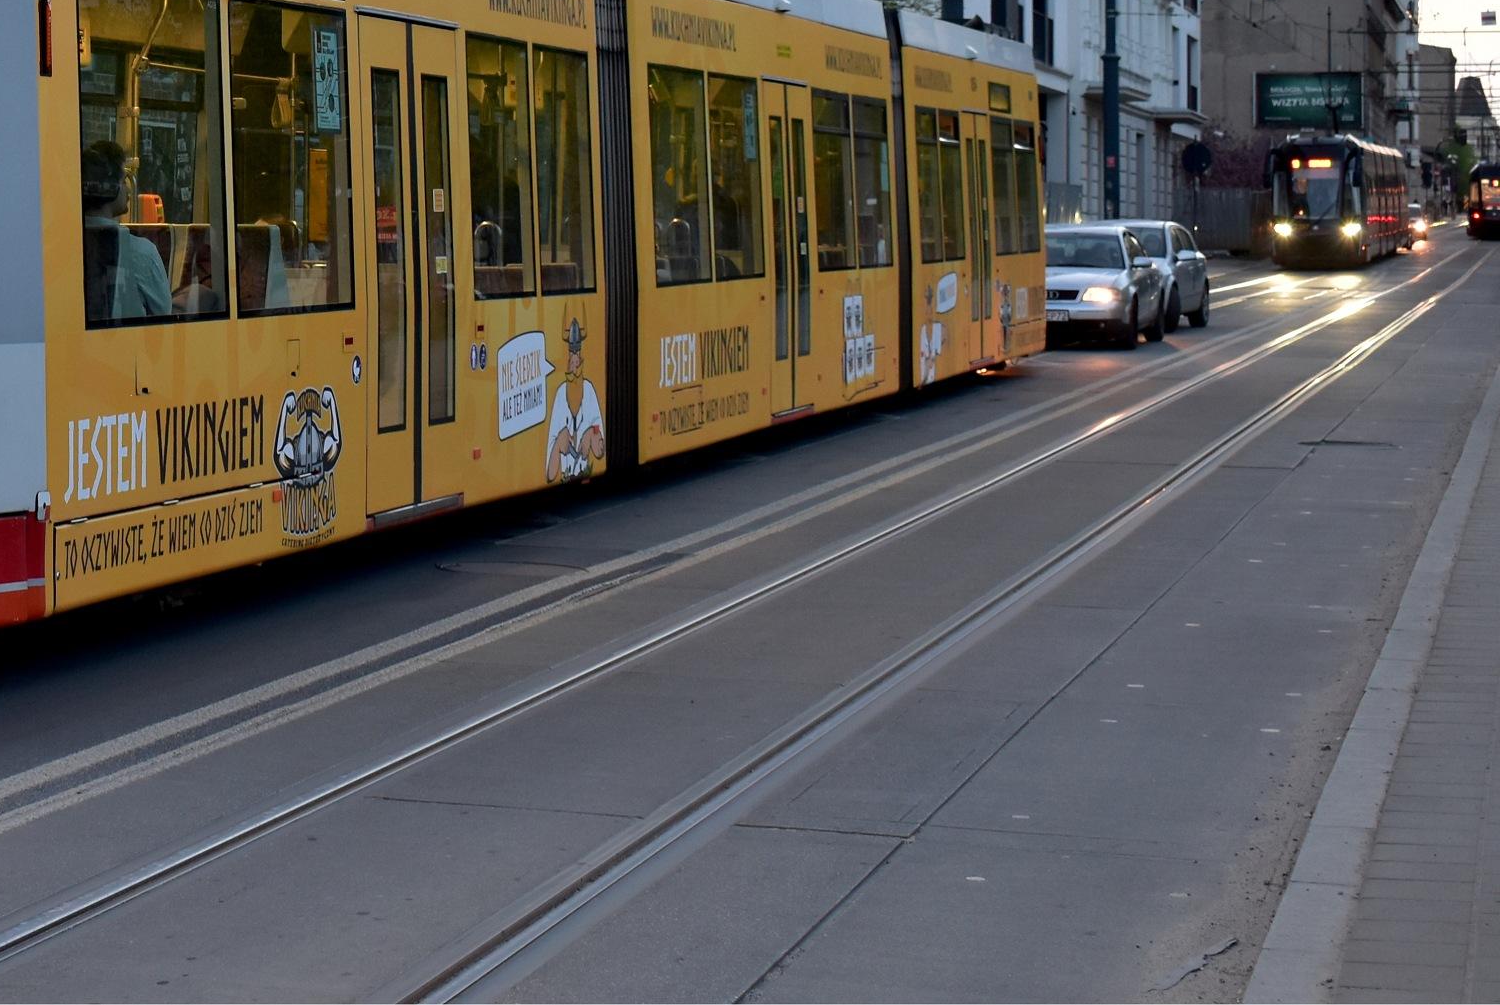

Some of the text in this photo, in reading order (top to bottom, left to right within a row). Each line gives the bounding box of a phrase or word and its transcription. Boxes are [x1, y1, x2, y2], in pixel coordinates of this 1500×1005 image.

[659, 324, 749, 388] JESTEM VIKINGIEM
[64, 393, 264, 505] JESTEM VIKINGIEM
[64, 538, 78, 580] TO
[151, 515, 165, 558] ŻE
[168, 513, 197, 554] WIEM
[200, 509, 212, 546] CO
[215, 498, 237, 543] DZIŚ
[239, 498, 264, 537] ZJEM
[280, 471, 337, 535] VIKINGA
